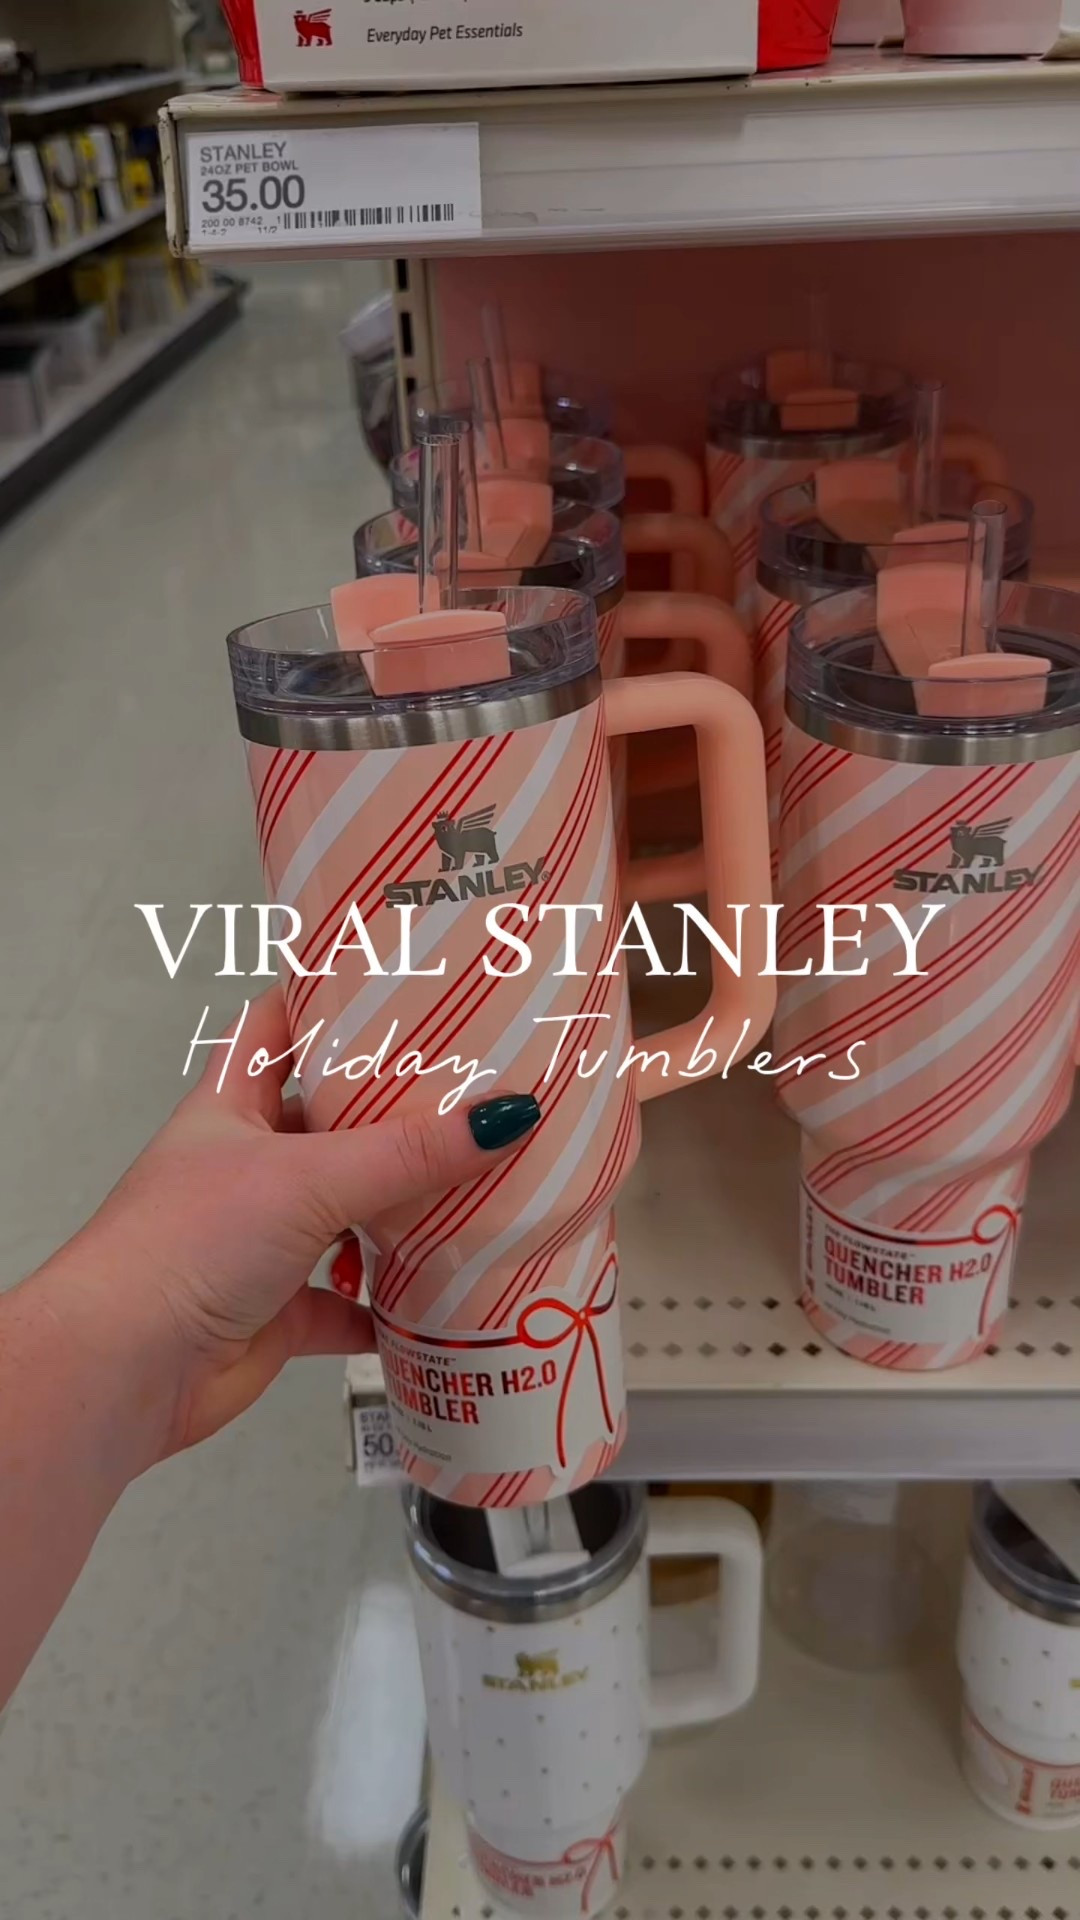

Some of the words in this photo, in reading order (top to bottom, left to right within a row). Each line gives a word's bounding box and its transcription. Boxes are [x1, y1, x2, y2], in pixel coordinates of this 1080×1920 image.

[367, 26, 427, 45] Everyday
[430, 25, 452, 41] Pet
[456, 22, 523, 40] Essentials
[200, 141, 287, 163] STANLEY
[235, 162, 257, 174] PET
[262, 160, 298, 173] BOWL
[202, 174, 306, 213] 35.00
[824, 1235, 943, 1284] QUENCHER
[950, 1252, 993, 1282] H2.0
[824, 1256, 924, 1305] TUMBLER
[383, 1345, 494, 1397] UENCHER
[501, 1359, 557, 1395] H2.0
